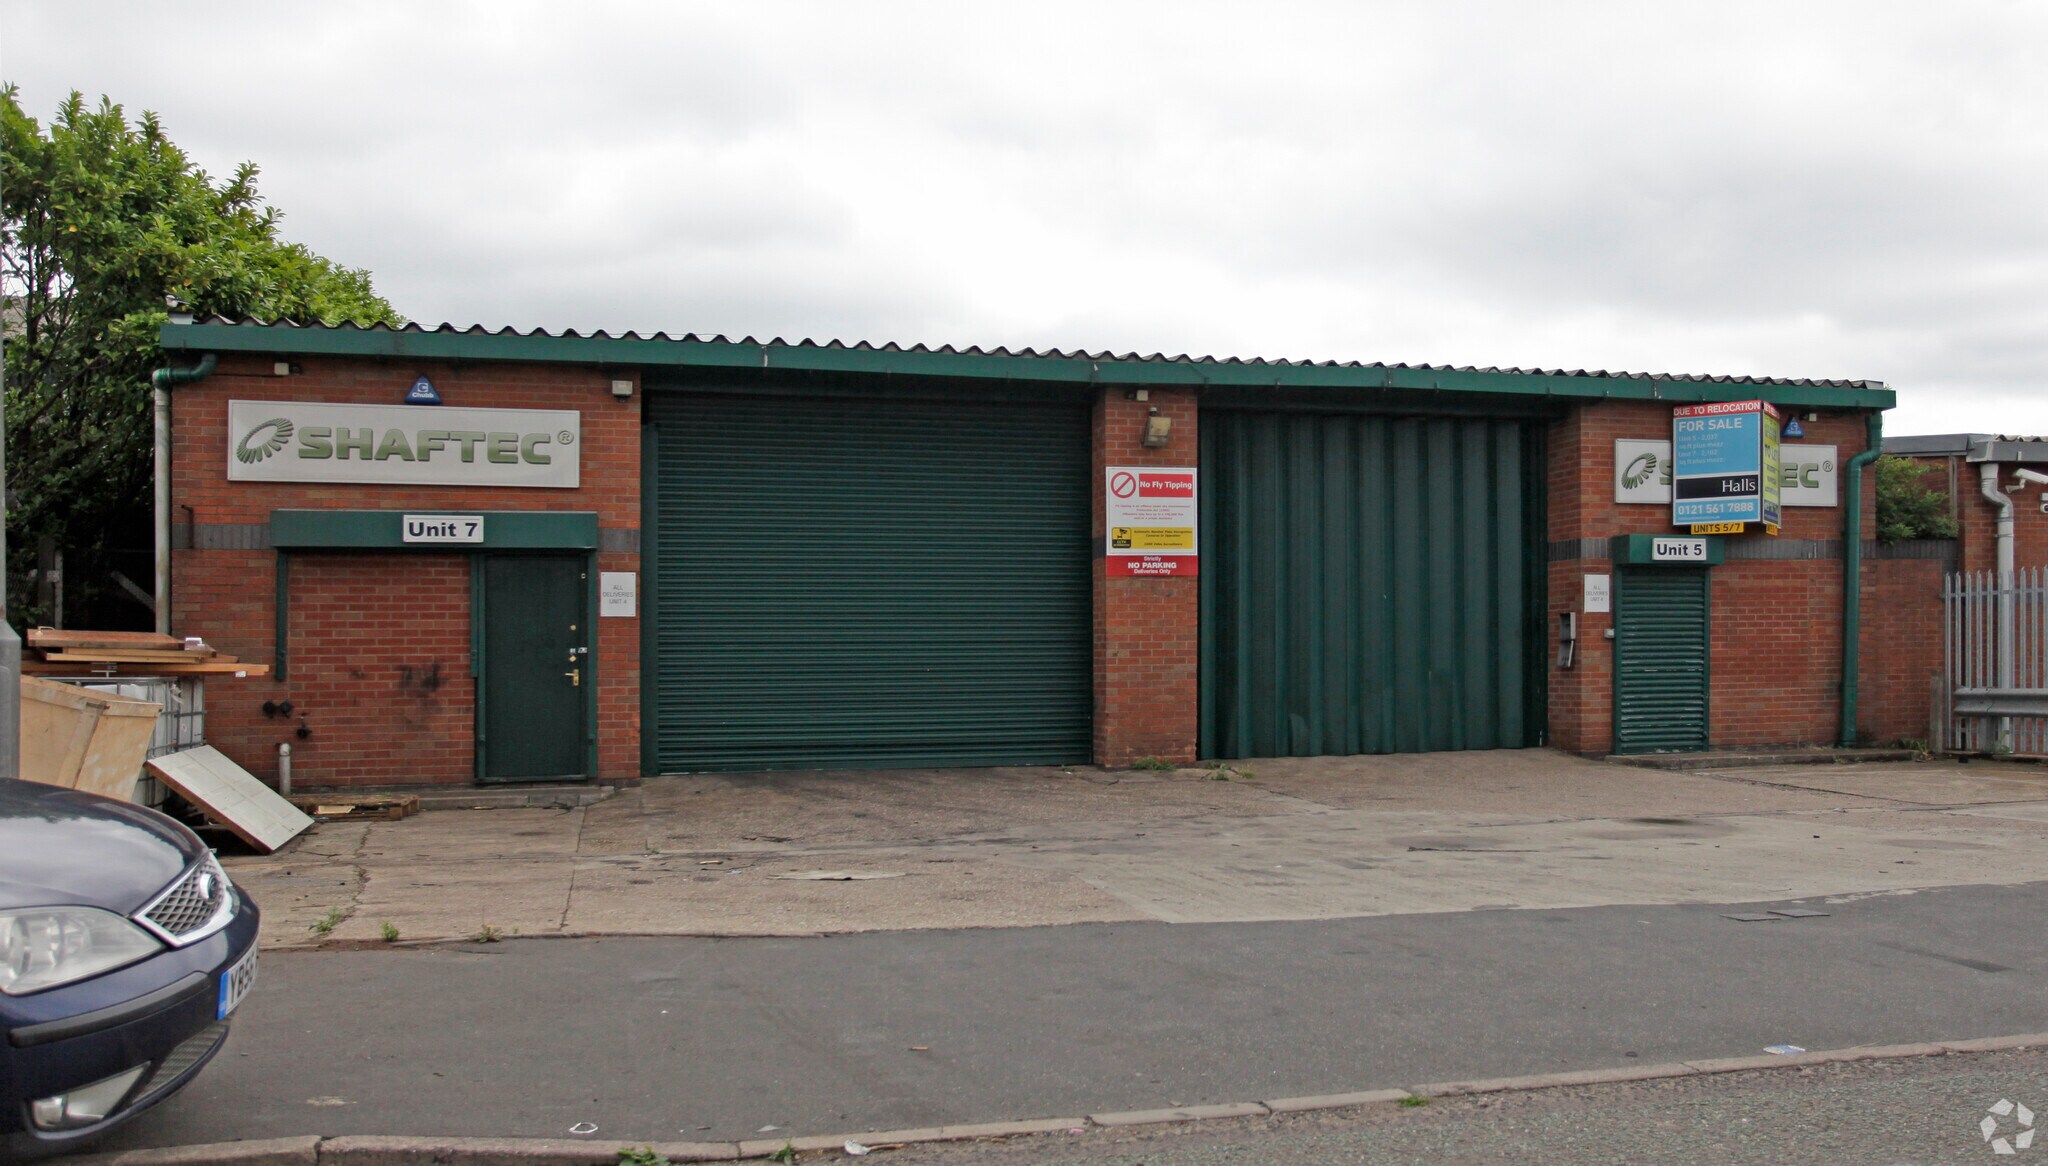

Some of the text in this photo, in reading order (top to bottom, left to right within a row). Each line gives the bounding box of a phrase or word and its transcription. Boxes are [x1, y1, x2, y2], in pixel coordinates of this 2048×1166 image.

[1673, 407, 1690, 416] DUE
[1693, 405, 1705, 415] TO
[1707, 401, 1760, 414] RELOCATION
[1678, 417, 1742, 432] FOR SALE
[1152, 481, 1164, 490] Fly
[1165, 481, 1193, 490] Tipping
[1722, 478, 1756, 493] Halls
[1678, 504, 1703, 515] 0121
[1705, 503, 1724, 514] 561
[1728, 501, 1754, 513] 7888
[408, 522, 478, 537] Unit 7
[1693, 522, 1740, 533] UNITS 5/7
[1656, 543, 1703, 556] Unit 5
[1159, 568, 1171, 576] Only
